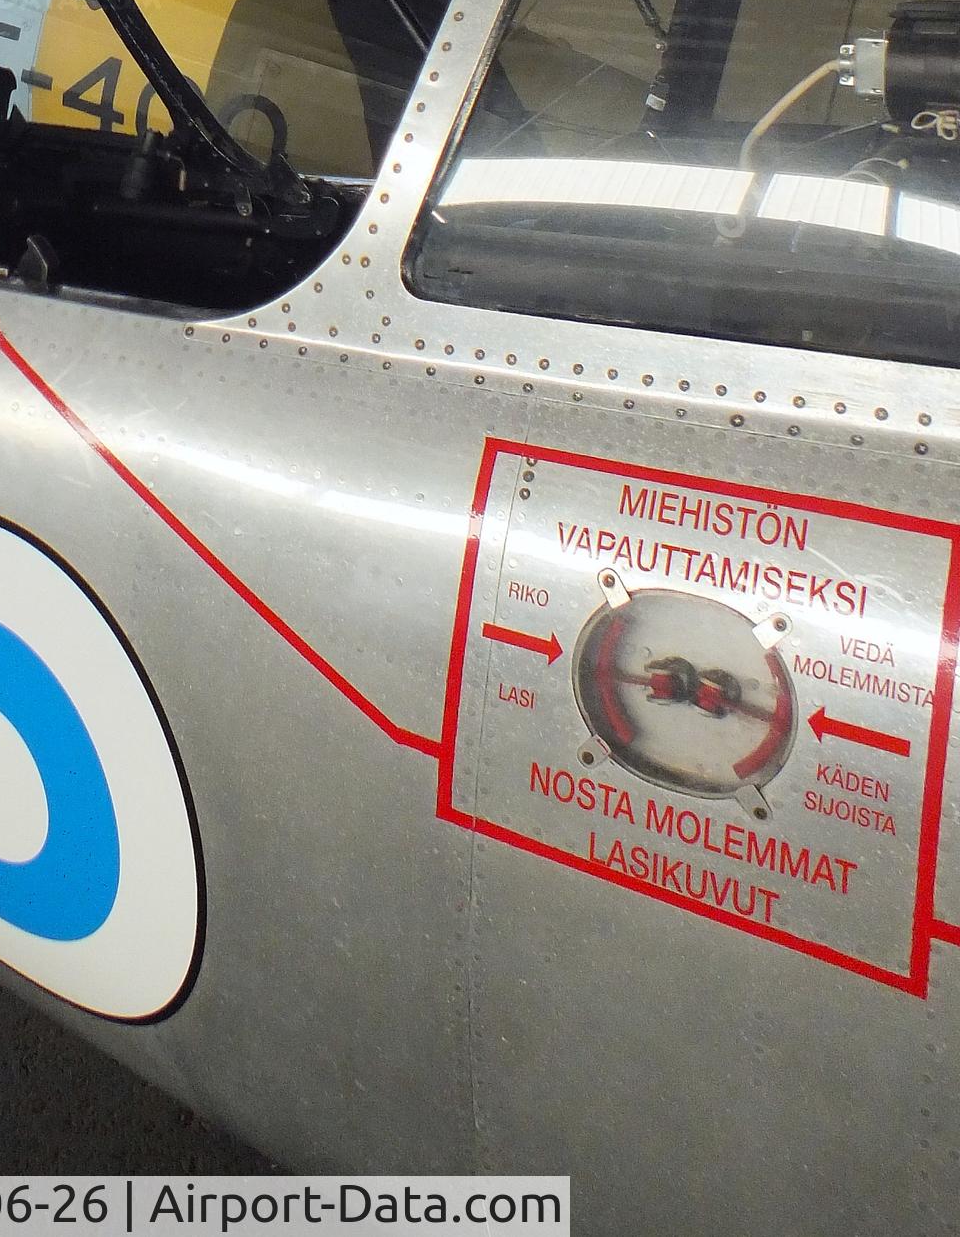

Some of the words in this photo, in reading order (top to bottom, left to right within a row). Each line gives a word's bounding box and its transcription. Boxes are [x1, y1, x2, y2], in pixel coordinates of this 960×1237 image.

[618, 484, 810, 551] MIEHISTÖN
[508, 581, 550, 607] RIKO
[557, 521, 868, 618] VAPAUTTAMISEKSI
[840, 635, 896, 668] VEDÄ
[498, 682, 536, 709] LASI
[793, 654, 936, 708] MOLEMMISTA
[816, 763, 890, 803] KÄDEN
[529, 762, 636, 825] NOSTA
[645, 798, 859, 895] MOLEMMAT
[804, 790, 897, 837] SIJOISTA
[590, 831, 781, 923] LASIKUVUT
